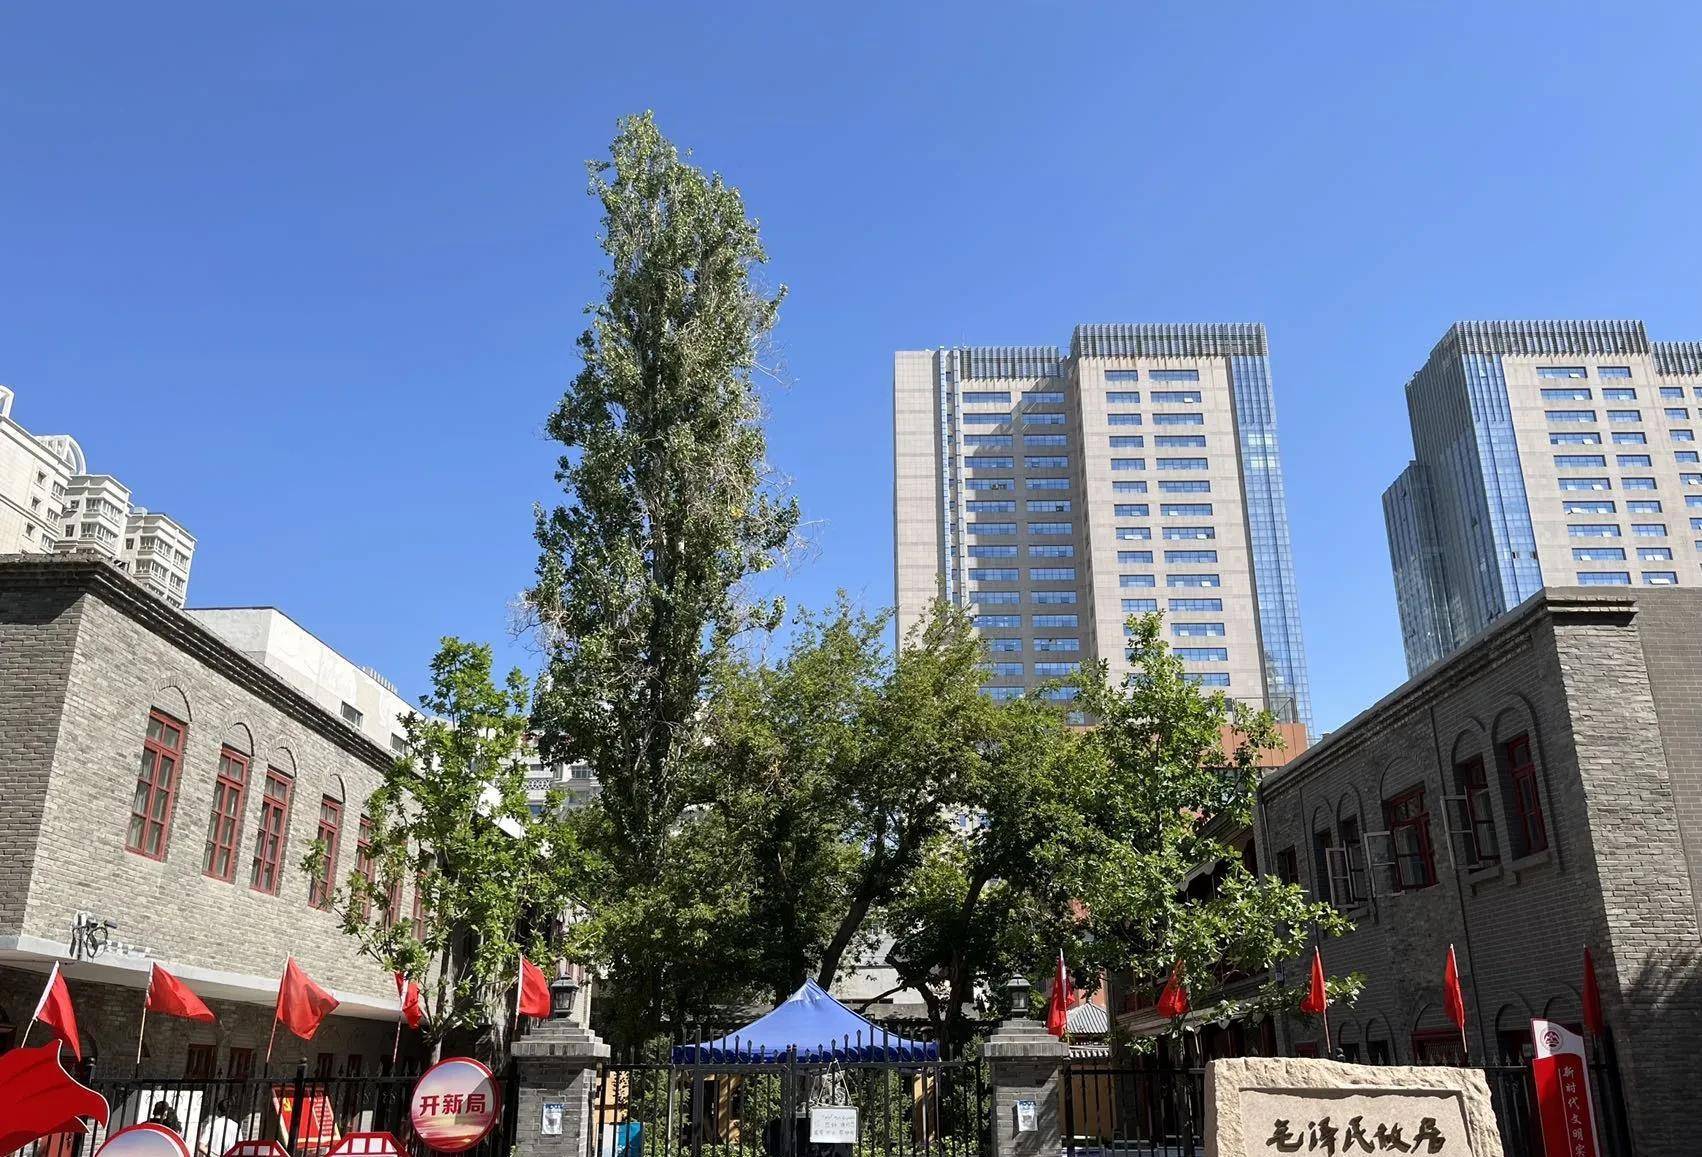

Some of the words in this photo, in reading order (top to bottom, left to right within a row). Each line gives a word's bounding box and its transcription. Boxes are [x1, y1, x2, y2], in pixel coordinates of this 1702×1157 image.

[419, 1093, 486, 1117] 开新局
[1266, 1115, 1446, 1157] 毛泽民故居
